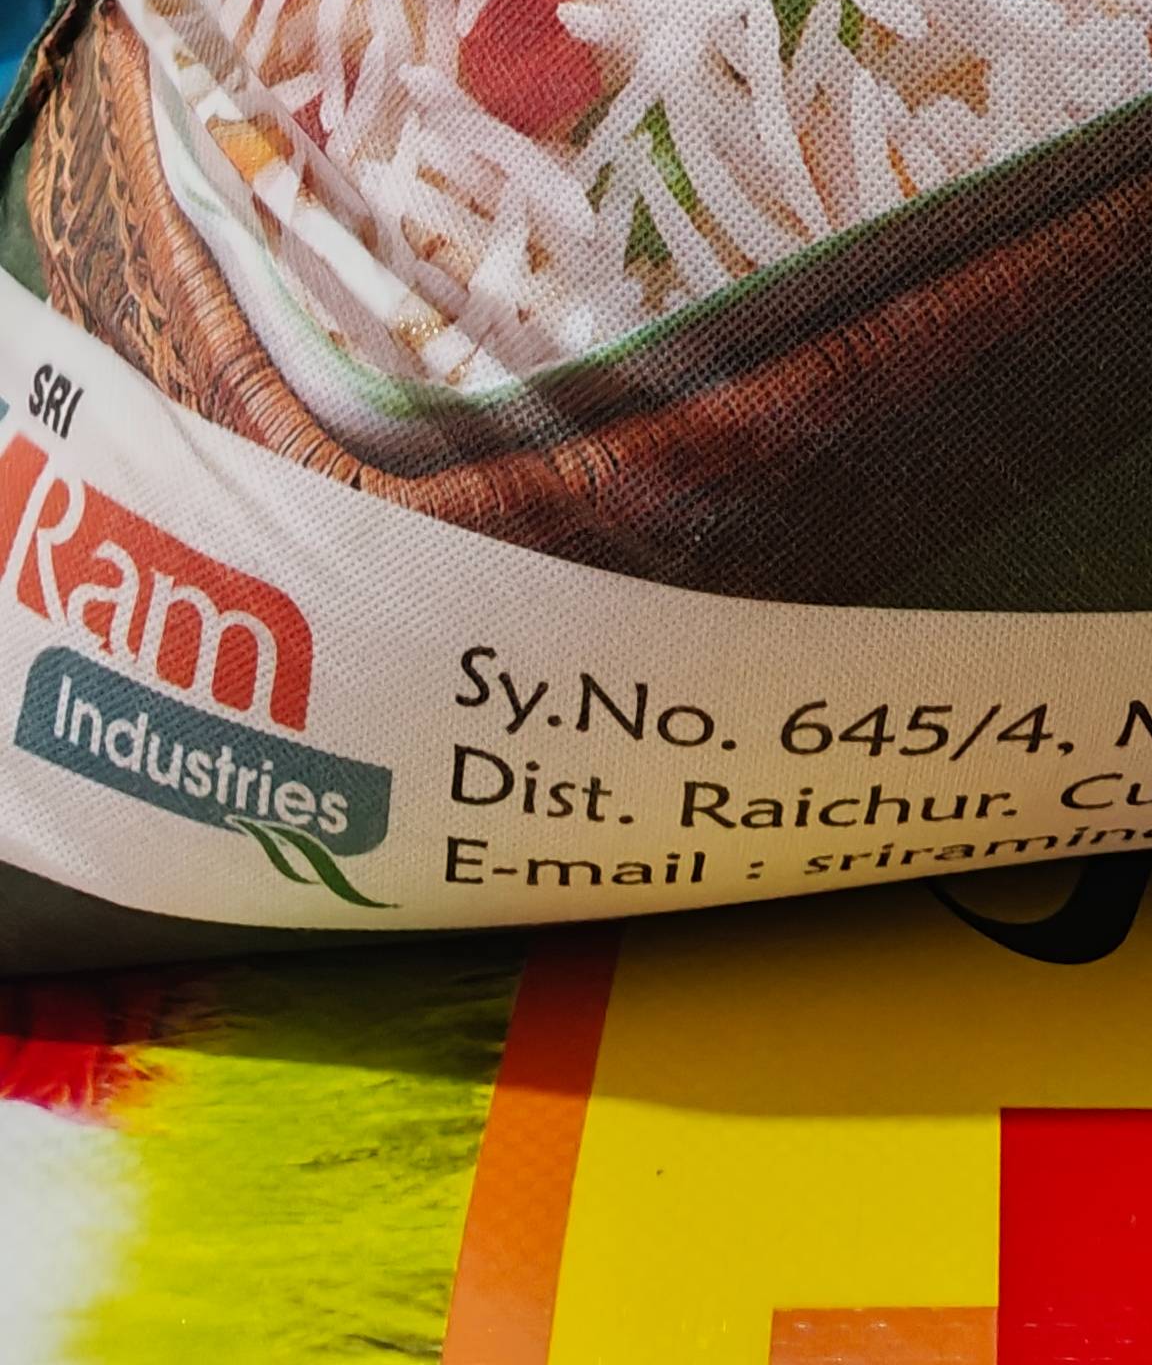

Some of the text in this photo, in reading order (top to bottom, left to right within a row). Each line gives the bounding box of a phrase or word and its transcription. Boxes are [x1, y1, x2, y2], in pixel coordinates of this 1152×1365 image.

[29, 362, 84, 439] SRI
[0, 469, 284, 729] Ram
[455, 645, 738, 753] Sy.No.
[779, 699, 1074, 761] 645/4,
[52, 677, 350, 835] Industries
[450, 744, 634, 826] Dist.
[680, 781, 1018, 831] Raichur.
[443, 836, 706, 886] E-mail
